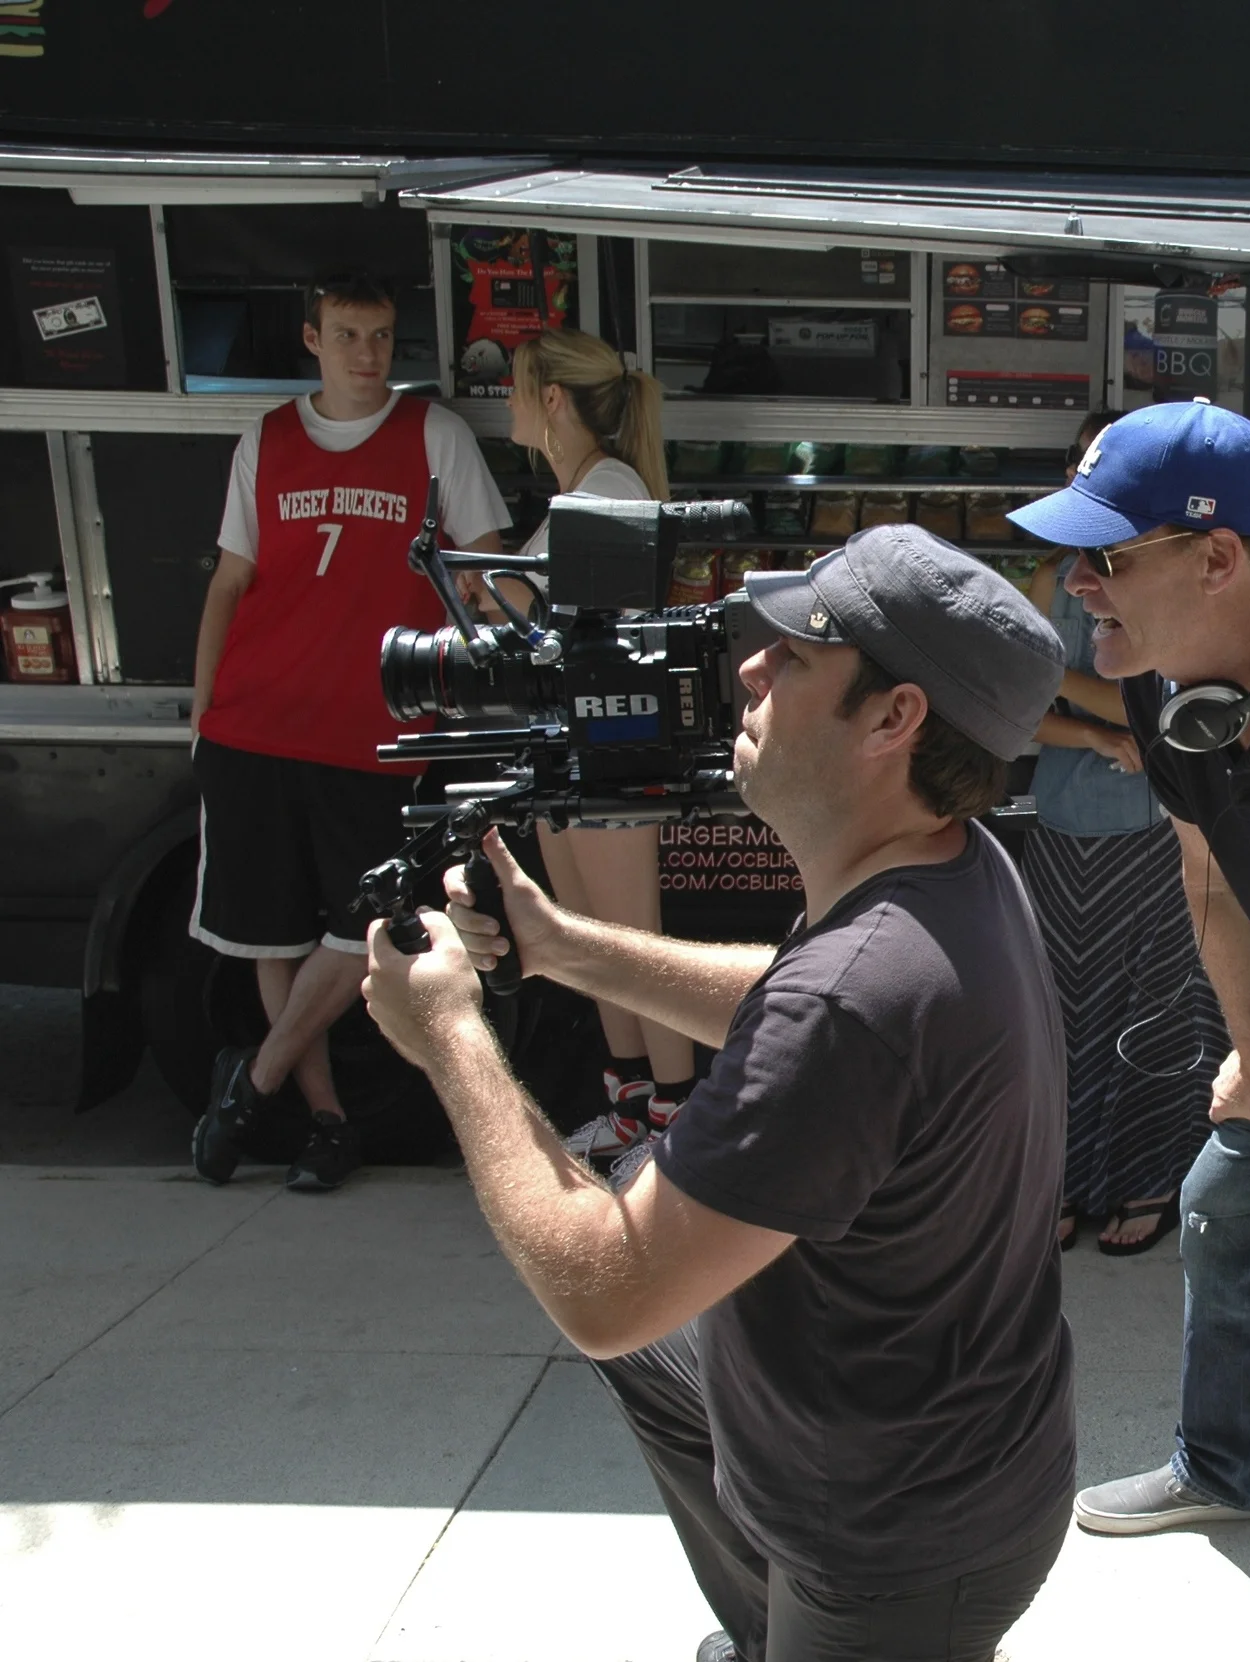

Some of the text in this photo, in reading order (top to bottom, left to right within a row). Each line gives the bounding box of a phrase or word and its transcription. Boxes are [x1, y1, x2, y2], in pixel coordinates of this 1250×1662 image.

[1156, 349, 1212, 377] BBQ
[470, 385, 485, 397] NO
[332, 486, 407, 523] BUCKETS
[316, 523, 343, 576] 7
[574, 694, 659, 718] RED
[679, 678, 694, 726] RED
